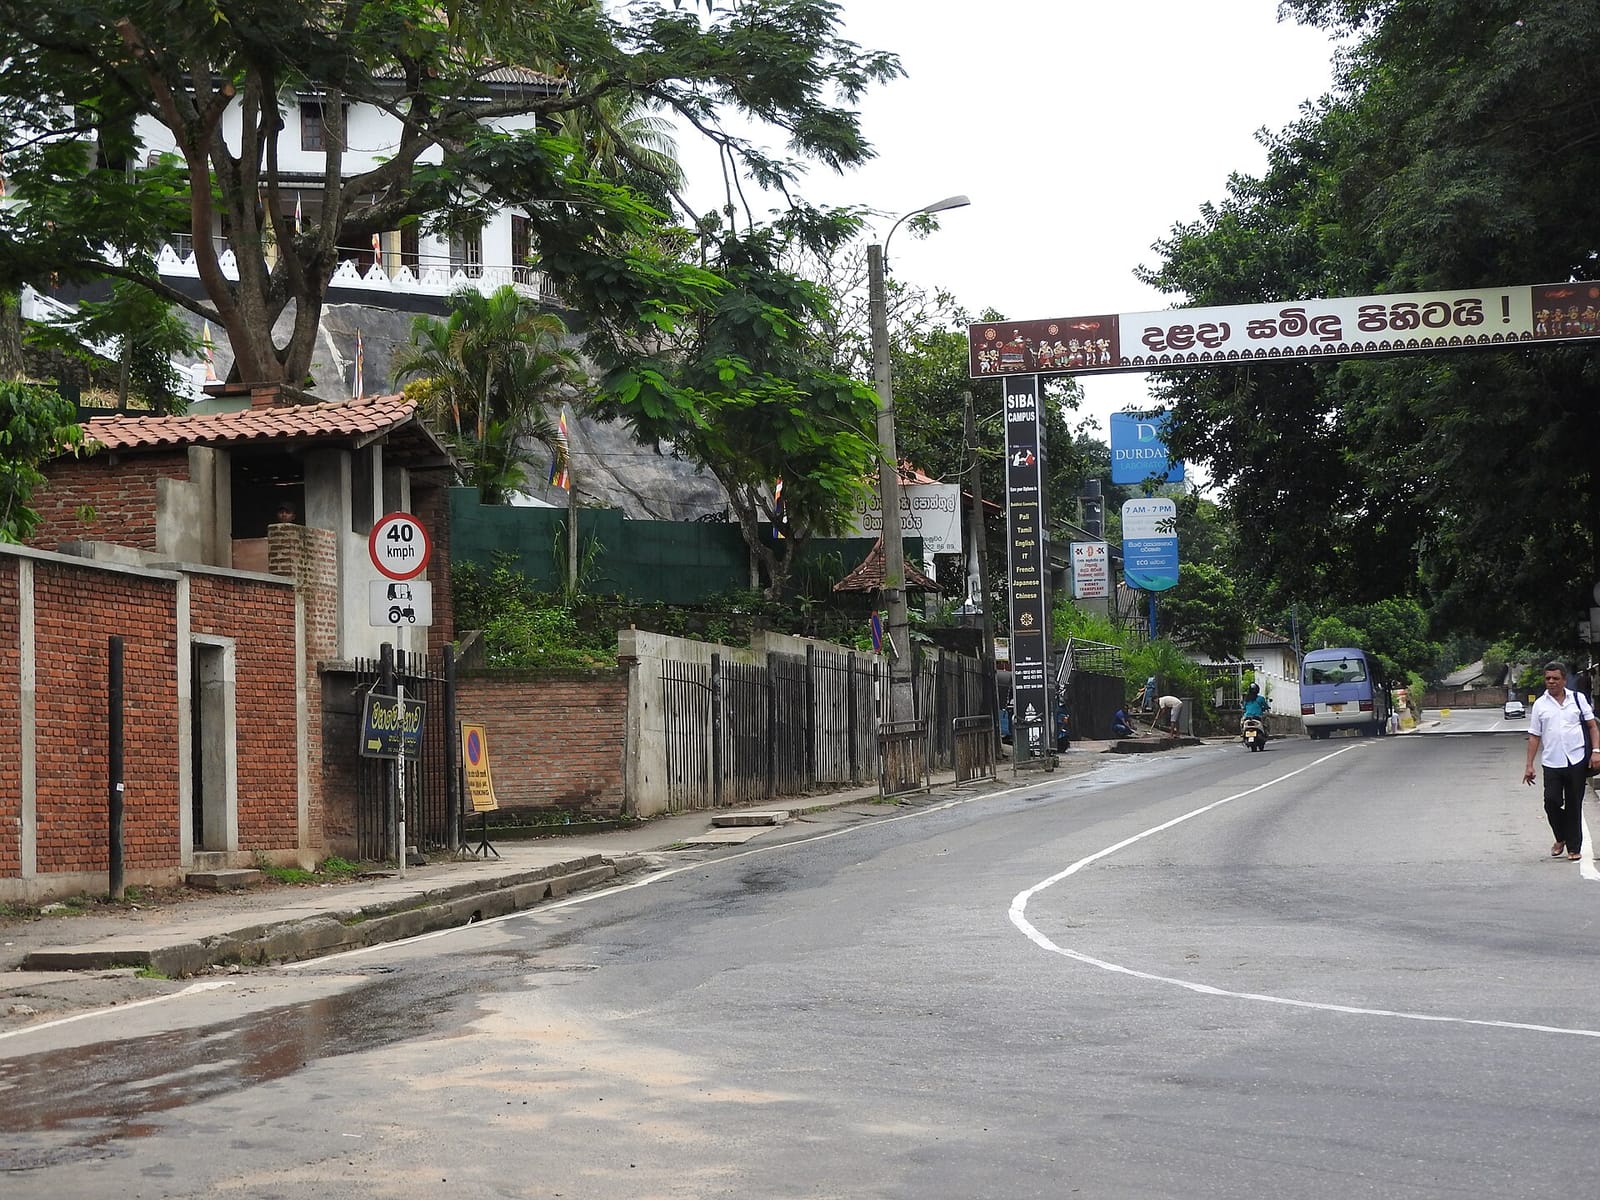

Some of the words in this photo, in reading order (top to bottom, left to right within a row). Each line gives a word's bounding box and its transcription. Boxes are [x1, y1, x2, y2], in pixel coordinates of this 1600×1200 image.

[1141, 321, 1231, 352] දළදා
[1008, 394, 1035, 409] SIBA
[1008, 411, 1036, 422] CAMPUS
[1115, 447, 1171, 461] DURDAN
[386, 524, 414, 542] 40
[1015, 540, 1035, 548] English
[387, 544, 415, 560] kmph
[1021, 552, 1029, 560] IT
[1016, 565, 1035, 573] French
